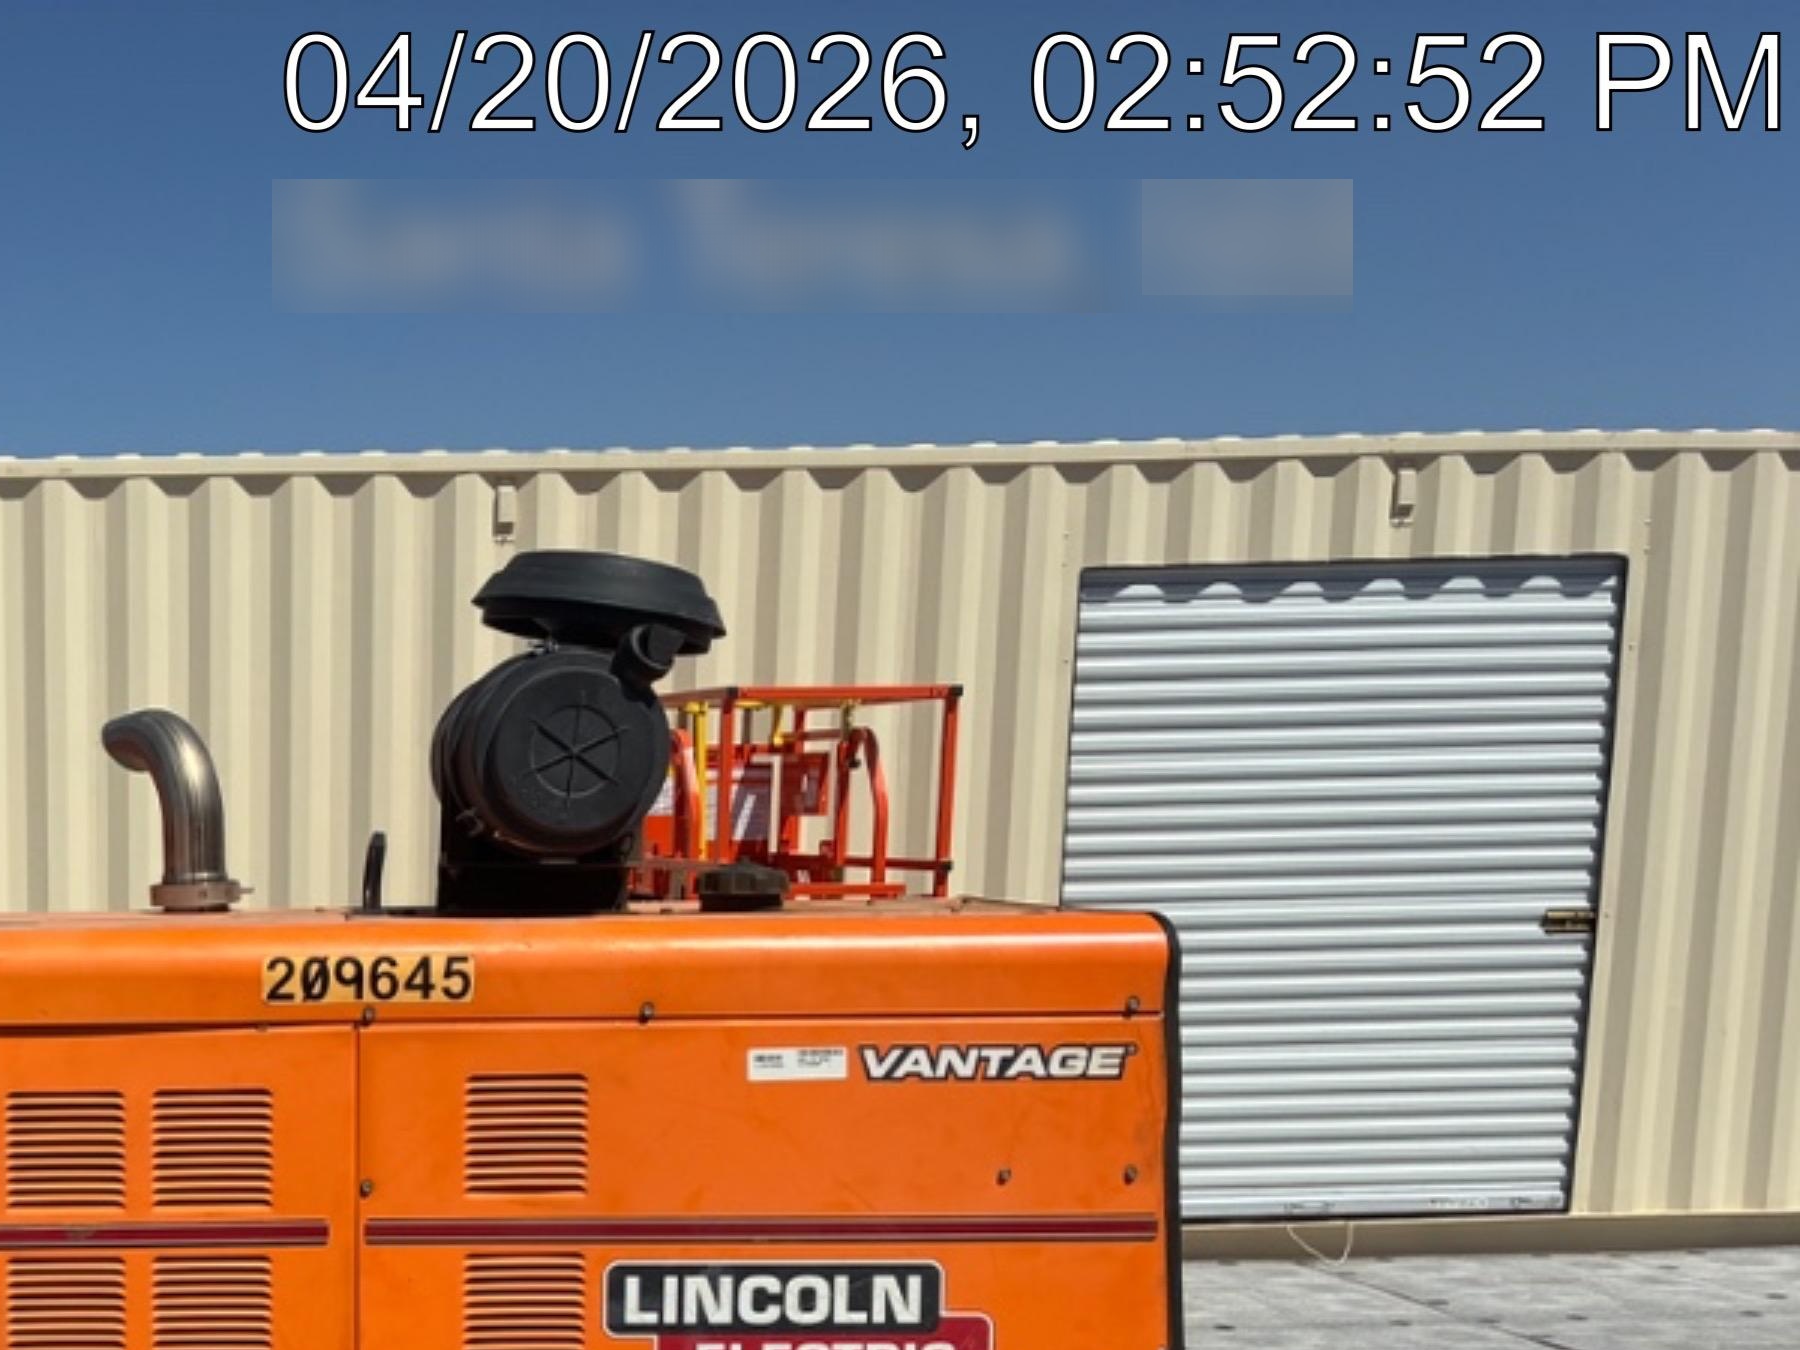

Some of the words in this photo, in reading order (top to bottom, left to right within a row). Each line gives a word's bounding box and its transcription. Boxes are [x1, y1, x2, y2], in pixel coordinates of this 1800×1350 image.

[265, 955, 472, 1002] 209645
[860, 1045, 1128, 1079] VANTAGE
[623, 1273, 923, 1326] LINCOLN
